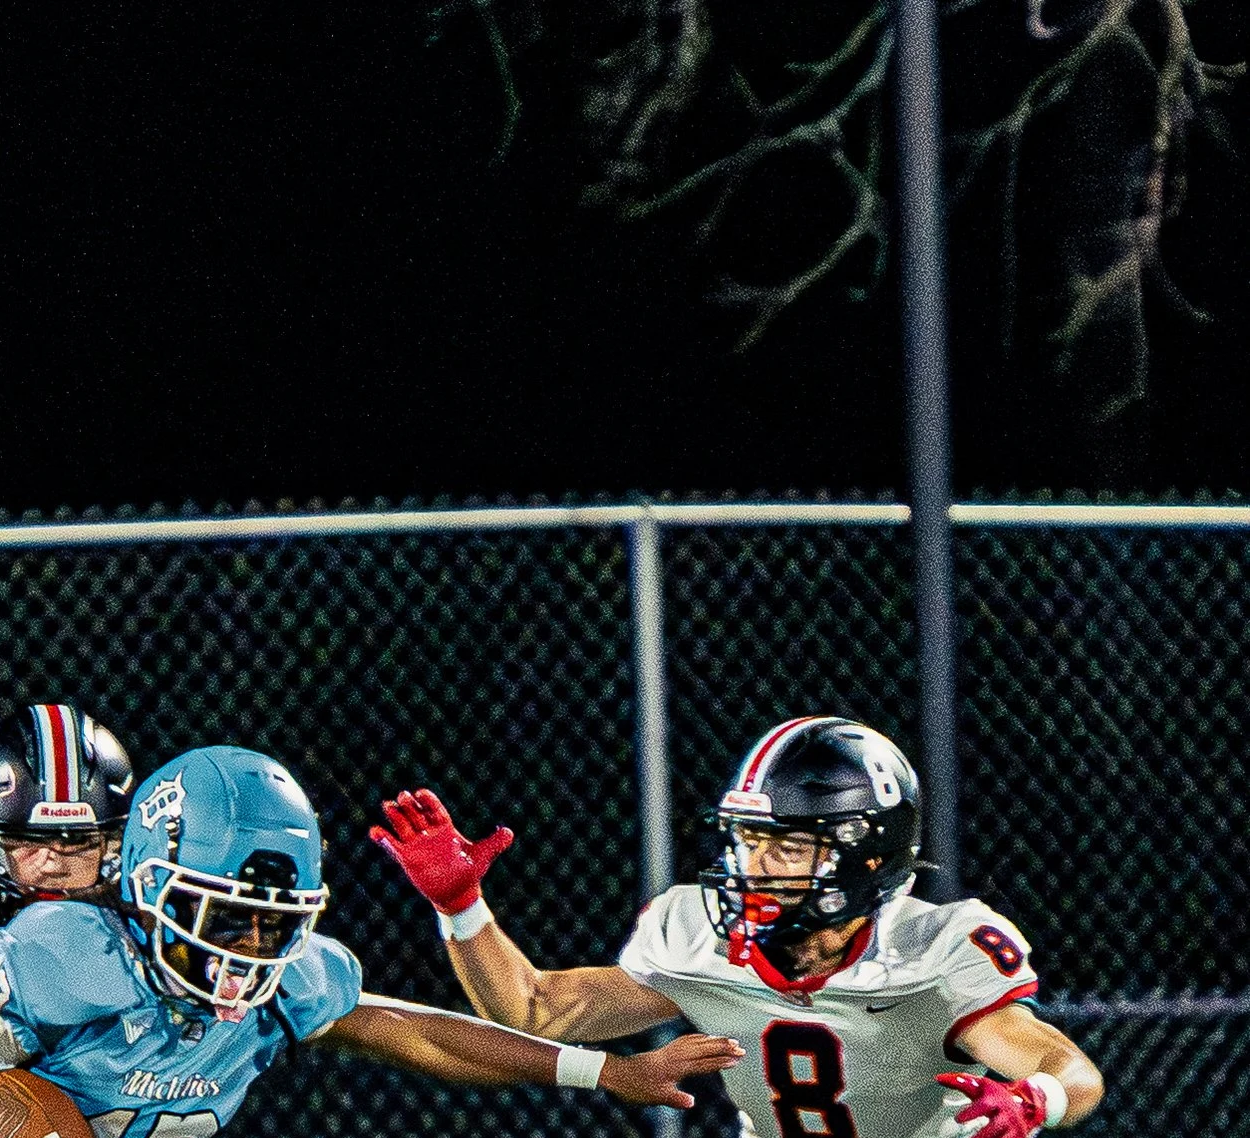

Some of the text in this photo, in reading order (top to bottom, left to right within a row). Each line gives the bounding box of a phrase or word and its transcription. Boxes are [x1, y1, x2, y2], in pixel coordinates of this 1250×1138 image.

[862, 744, 902, 808] 8
[40, 806, 88, 818] Riddell
[969, 924, 1025, 978] 8
